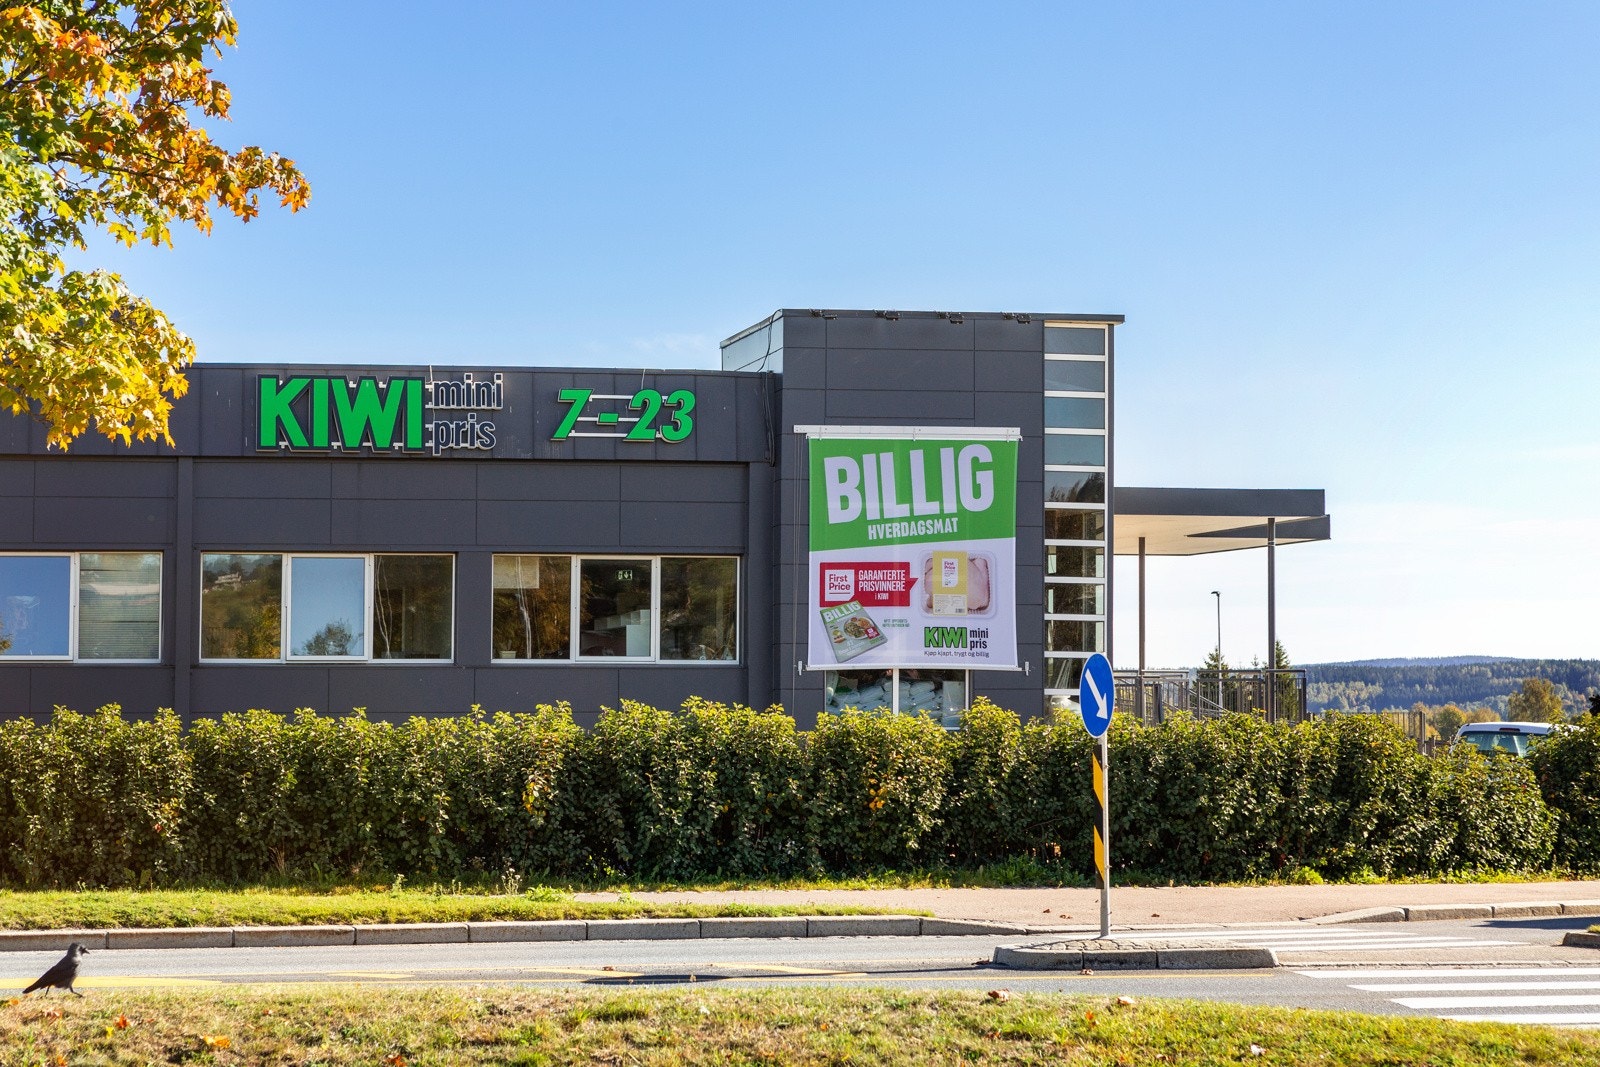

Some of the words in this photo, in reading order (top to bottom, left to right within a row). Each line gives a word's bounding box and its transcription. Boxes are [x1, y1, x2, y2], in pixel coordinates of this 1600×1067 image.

[432, 373, 503, 409] mini
[257, 374, 425, 452] KIWI
[432, 413, 496, 456] pris
[824, 444, 994, 524] BILLIG
[868, 517, 958, 540] HVERDAGSMAT
[829, 574, 848, 582] First
[858, 570, 905, 580] GARANTERTE
[829, 582, 851, 591] Price
[858, 581, 905, 591] PRISVINNERE
[823, 602, 862, 623] BILLIG
[924, 626, 967, 648] KIWI
[969, 628, 989, 639] mini
[969, 638, 988, 651] pris
